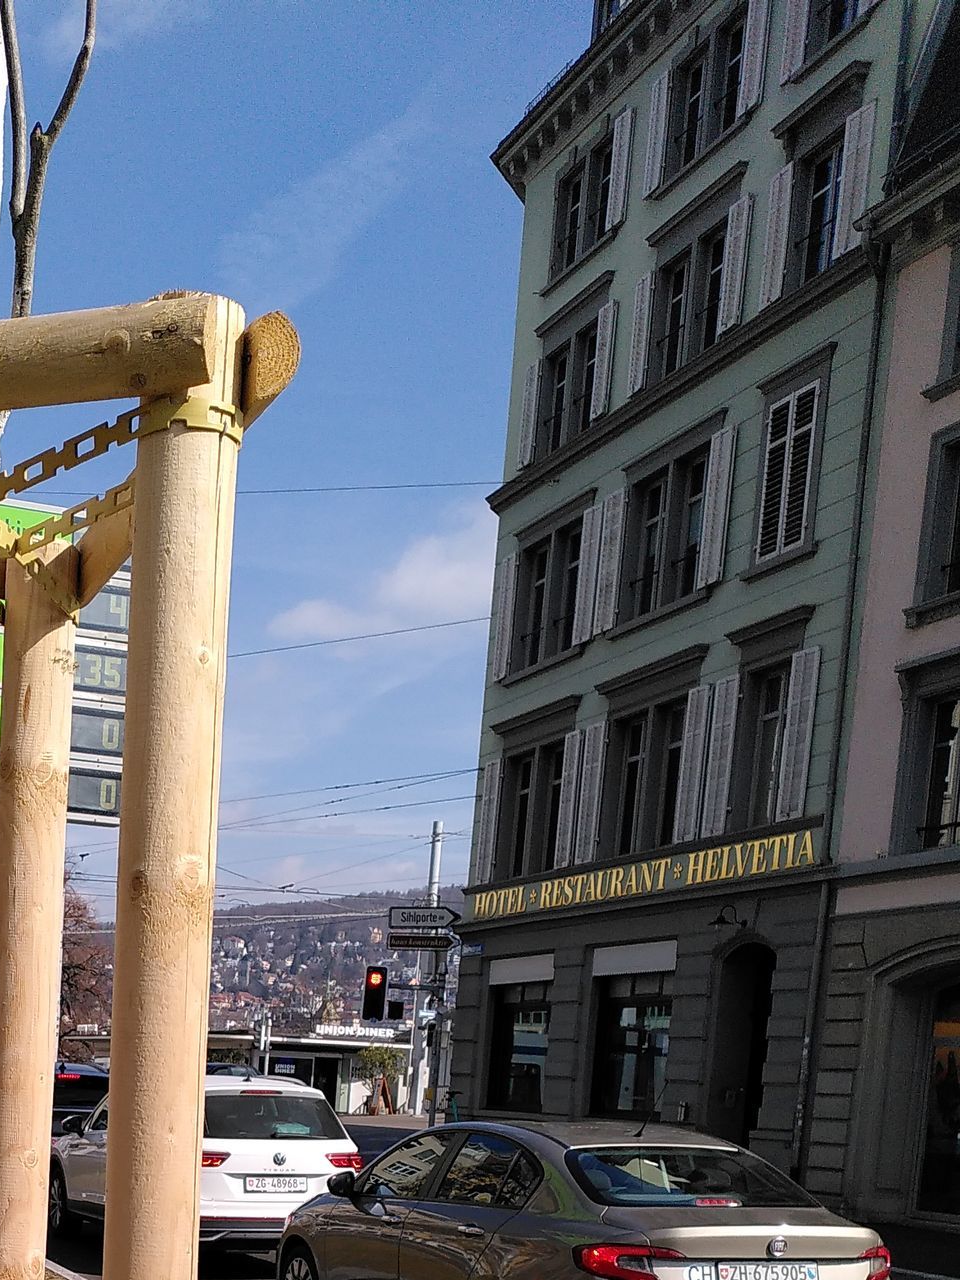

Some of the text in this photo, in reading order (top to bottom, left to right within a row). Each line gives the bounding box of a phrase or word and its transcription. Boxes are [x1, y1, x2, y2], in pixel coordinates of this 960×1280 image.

[110, 593, 127, 627] 4
[74, 654, 121, 689] 35
[473, 830, 816, 919] HOTEL RESTAURANT HELVETIA
[400, 911, 438, 924] Sihlporte
[315, 1024, 355, 1037] UNION
[356, 1027, 395, 1038] DINER
